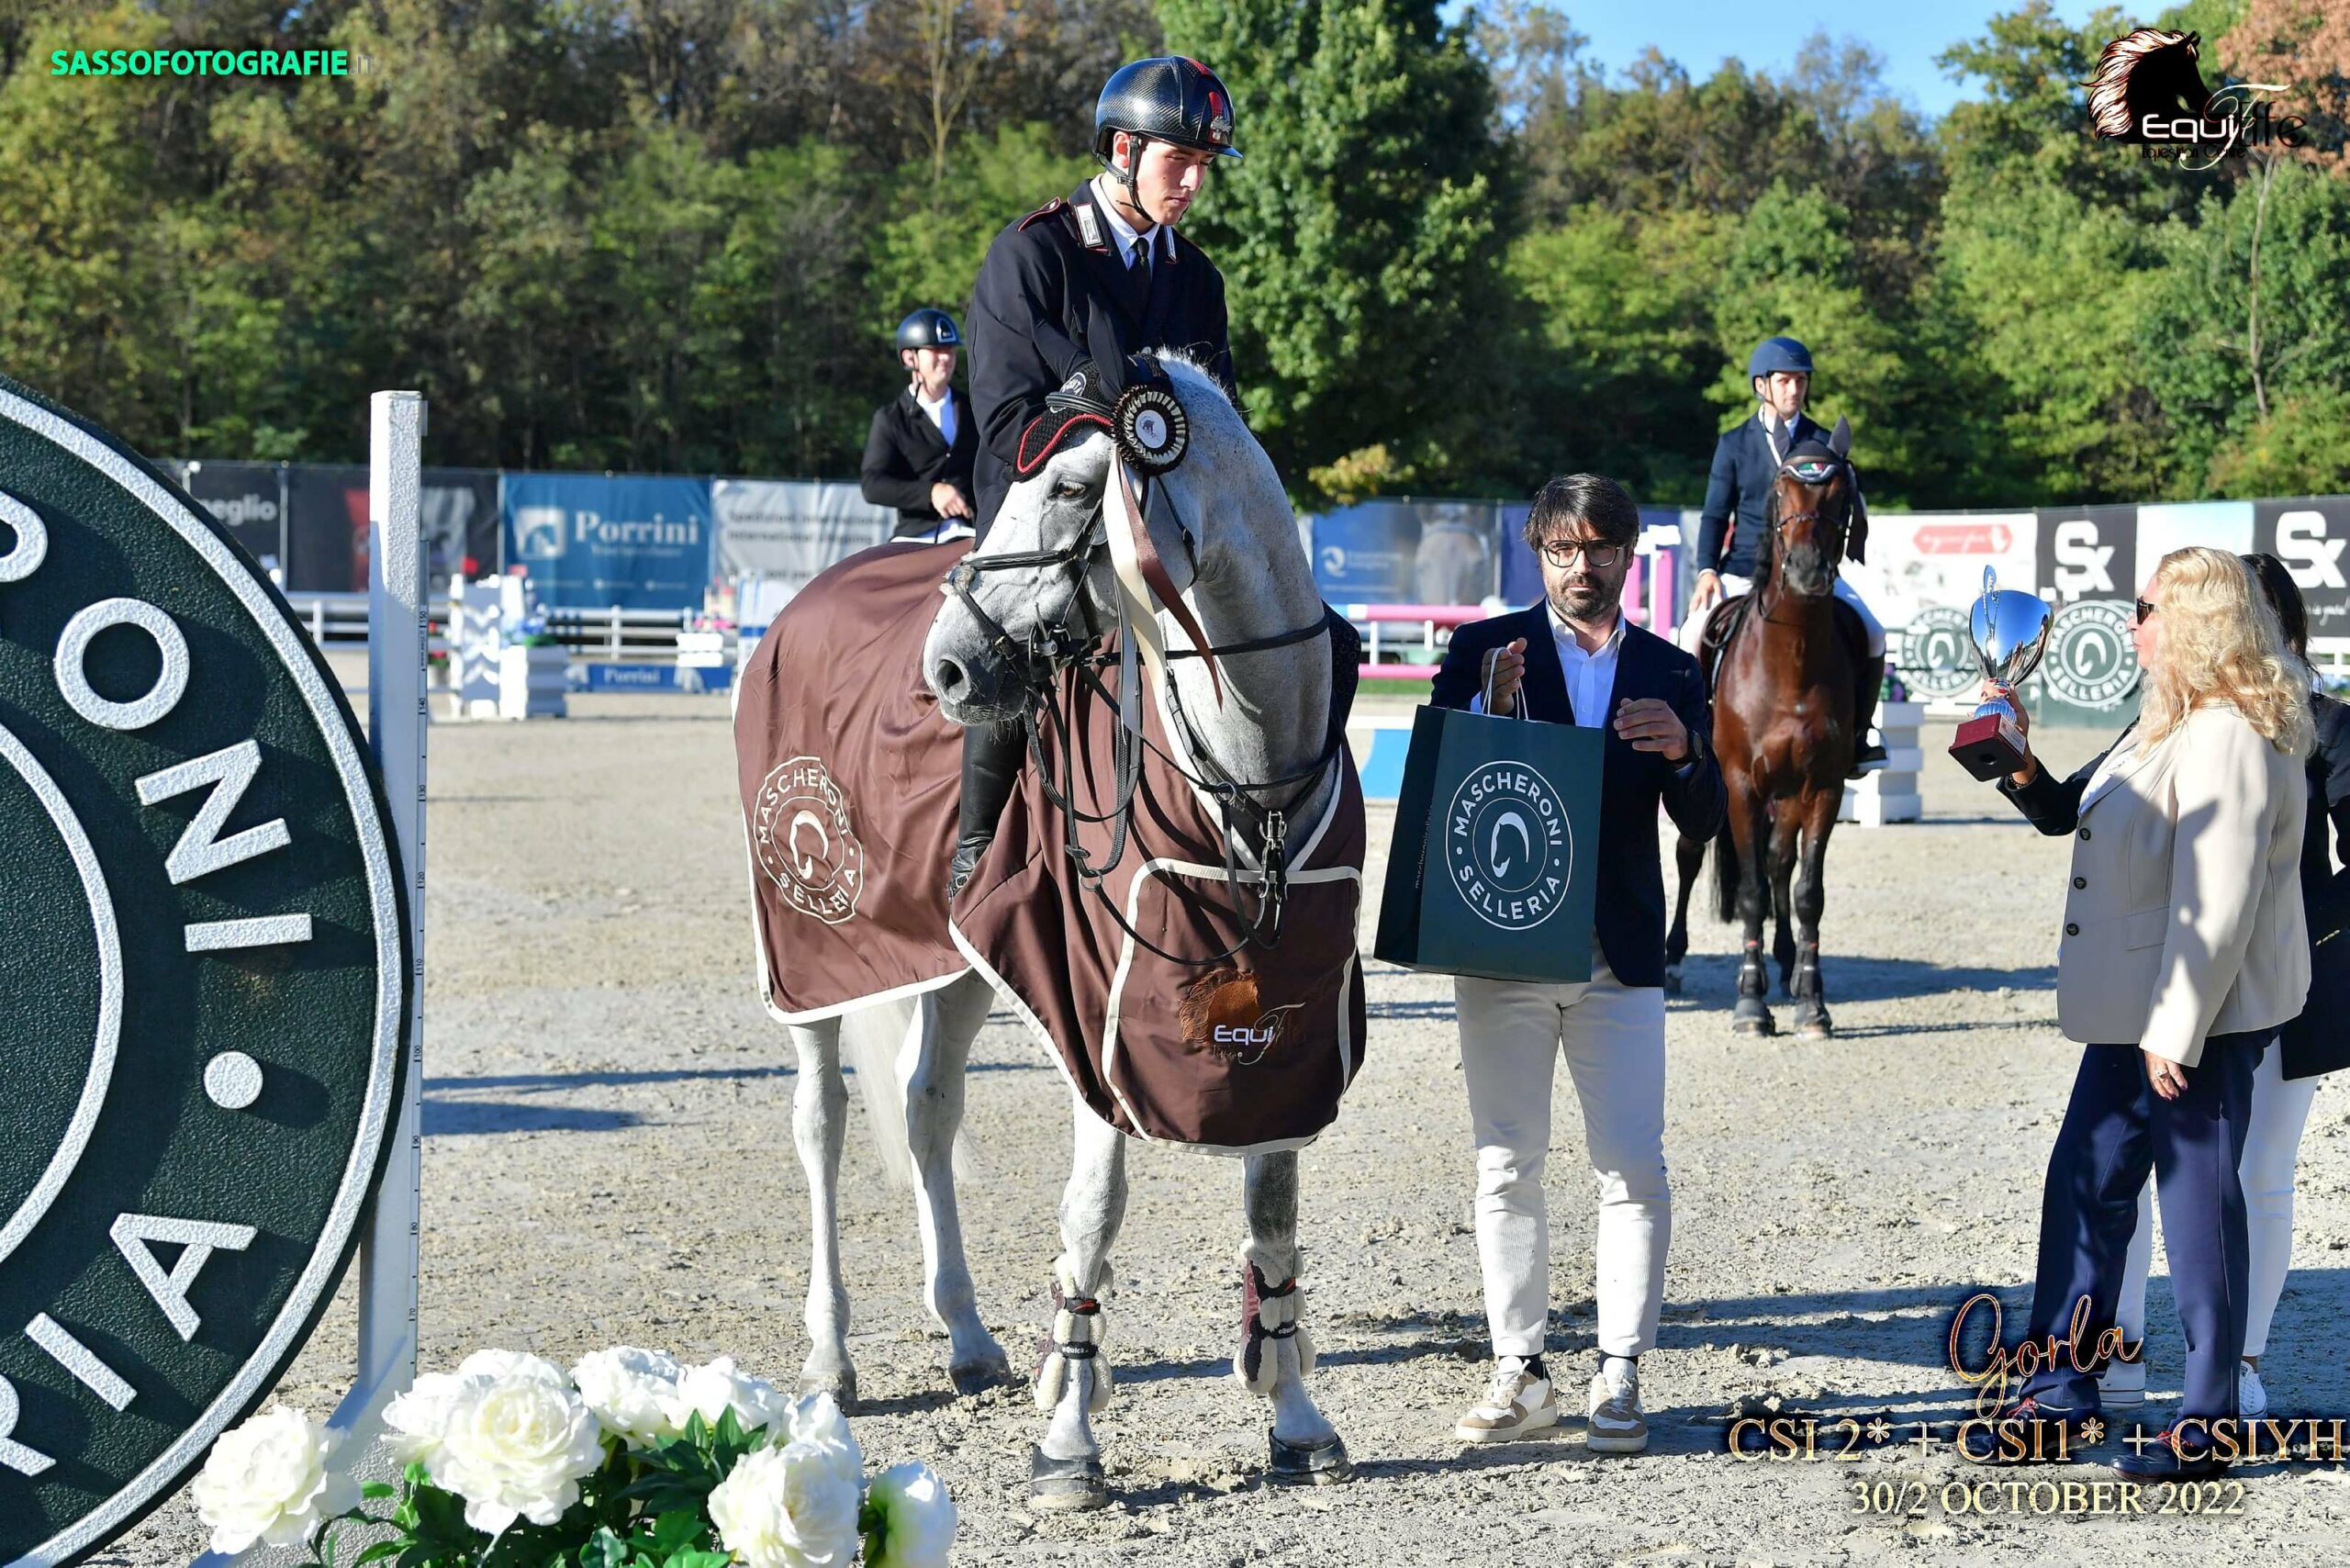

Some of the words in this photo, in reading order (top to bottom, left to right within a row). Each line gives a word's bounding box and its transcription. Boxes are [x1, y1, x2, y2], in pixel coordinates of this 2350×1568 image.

[575, 510, 699, 544] Porrini
[604, 667, 661, 684] Porrini
[2050, 666, 2132, 700] SELLERIA
[418, 784, 426, 798] 130
[759, 768, 848, 844] MASCHERONI
[1454, 772, 1562, 846] MASCHERONI
[417, 871, 425, 885] 120
[1459, 864, 1561, 920] SELLERIA
[412, 1136, 420, 1145] 90
[410, 1222, 418, 1231] 80
[408, 1307, 416, 1316] 70
